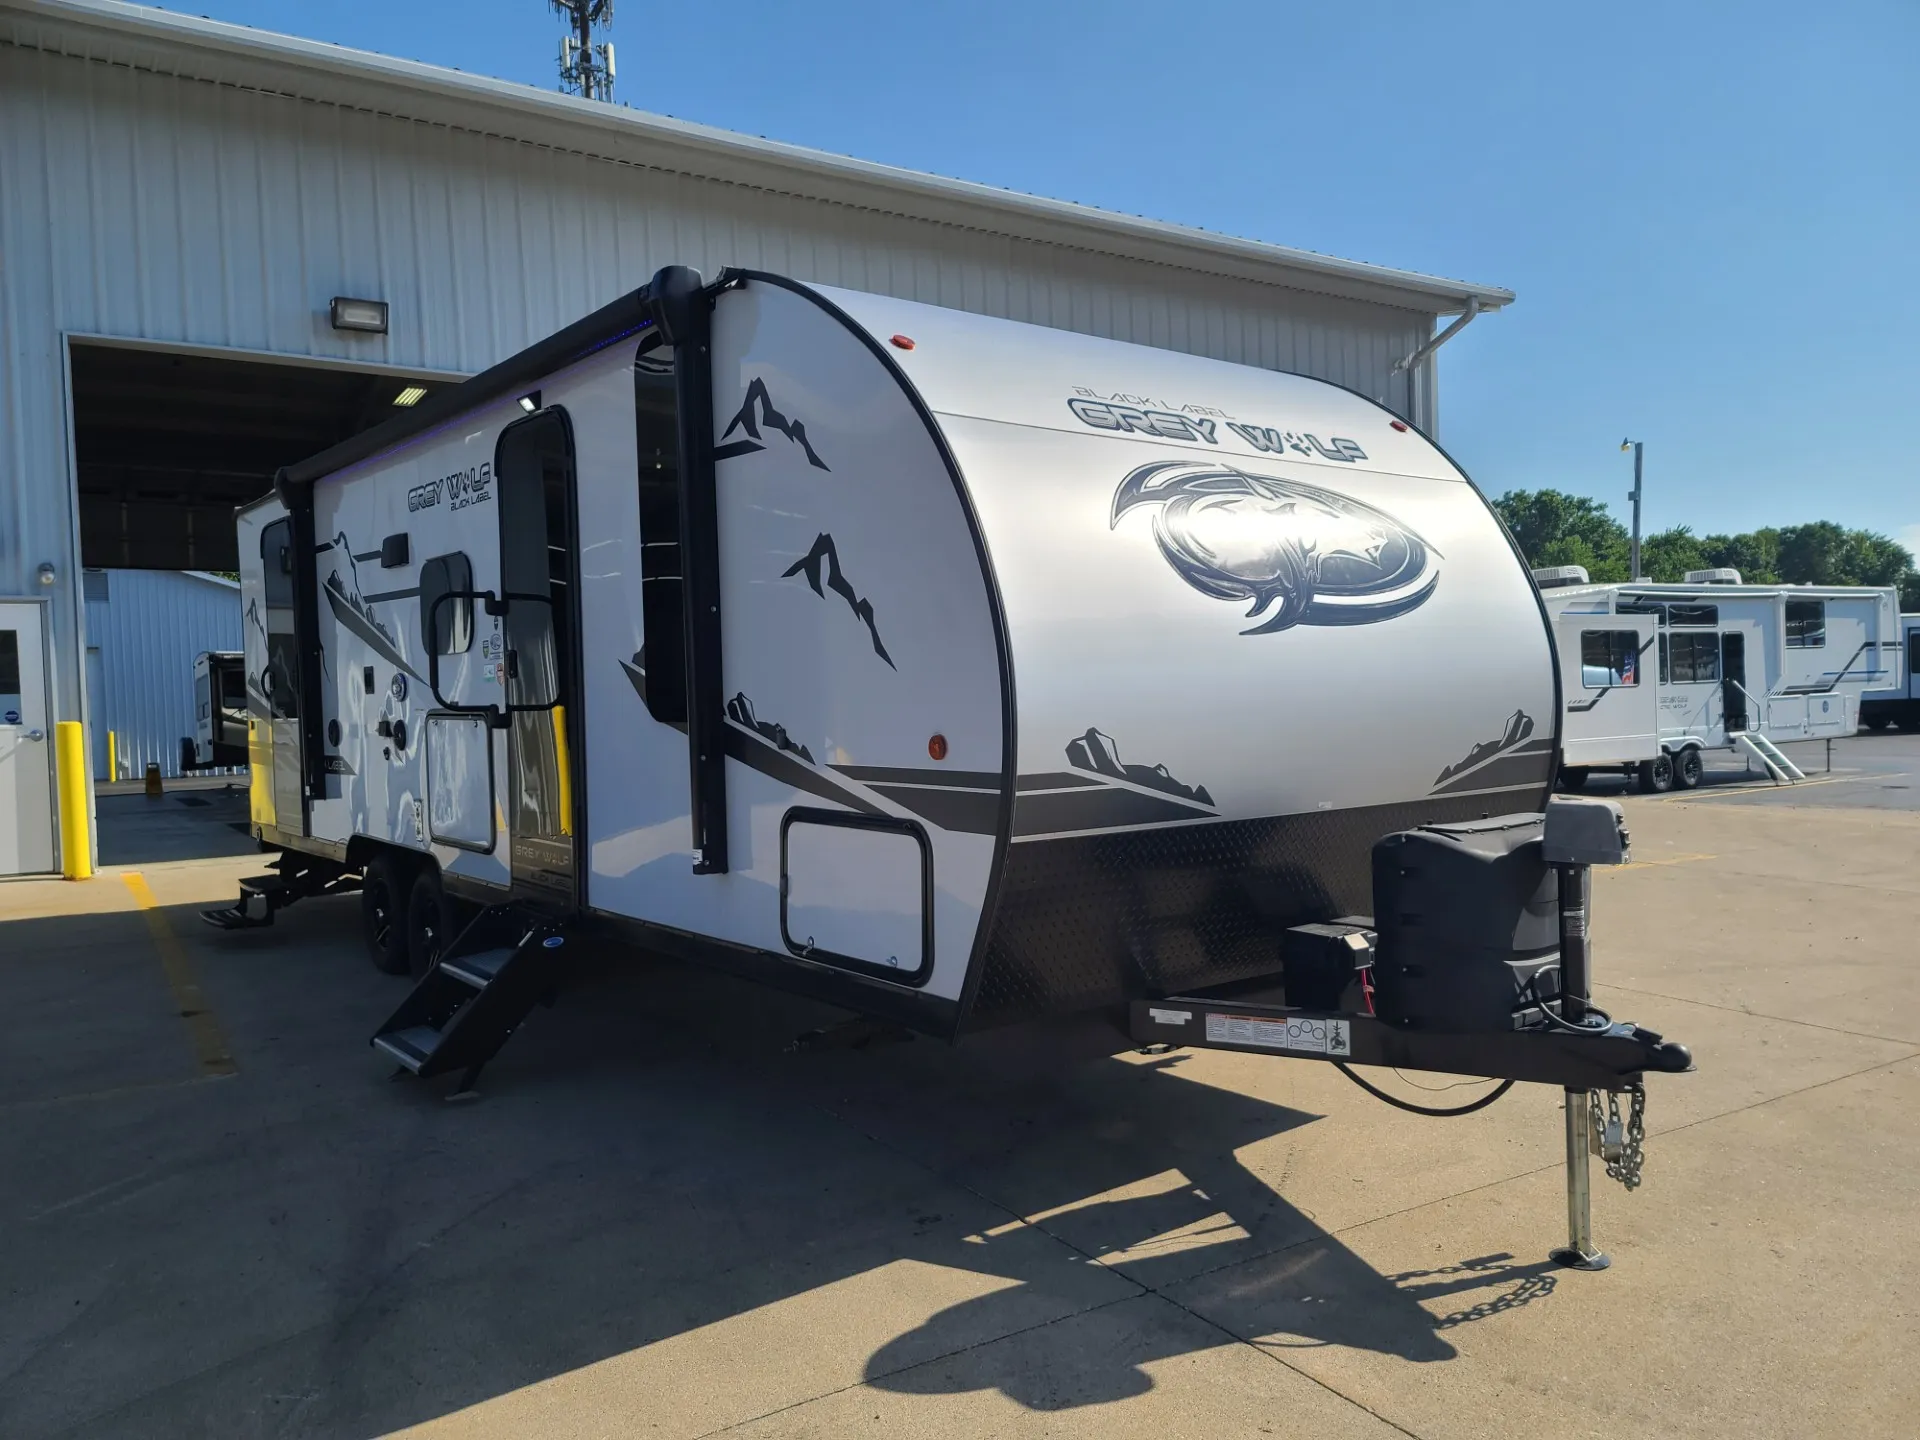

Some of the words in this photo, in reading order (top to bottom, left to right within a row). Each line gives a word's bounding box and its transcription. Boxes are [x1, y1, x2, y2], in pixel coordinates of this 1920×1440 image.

[1072, 385, 1157, 408] BLACK
[1160, 399, 1236, 420] LABEL
[1067, 397, 1218, 445] GREY
[408, 478, 444, 512] GREY
[450, 498, 470, 511] BLACK
[471, 491, 491, 505] LABEL
[515, 845, 540, 858] GREY
